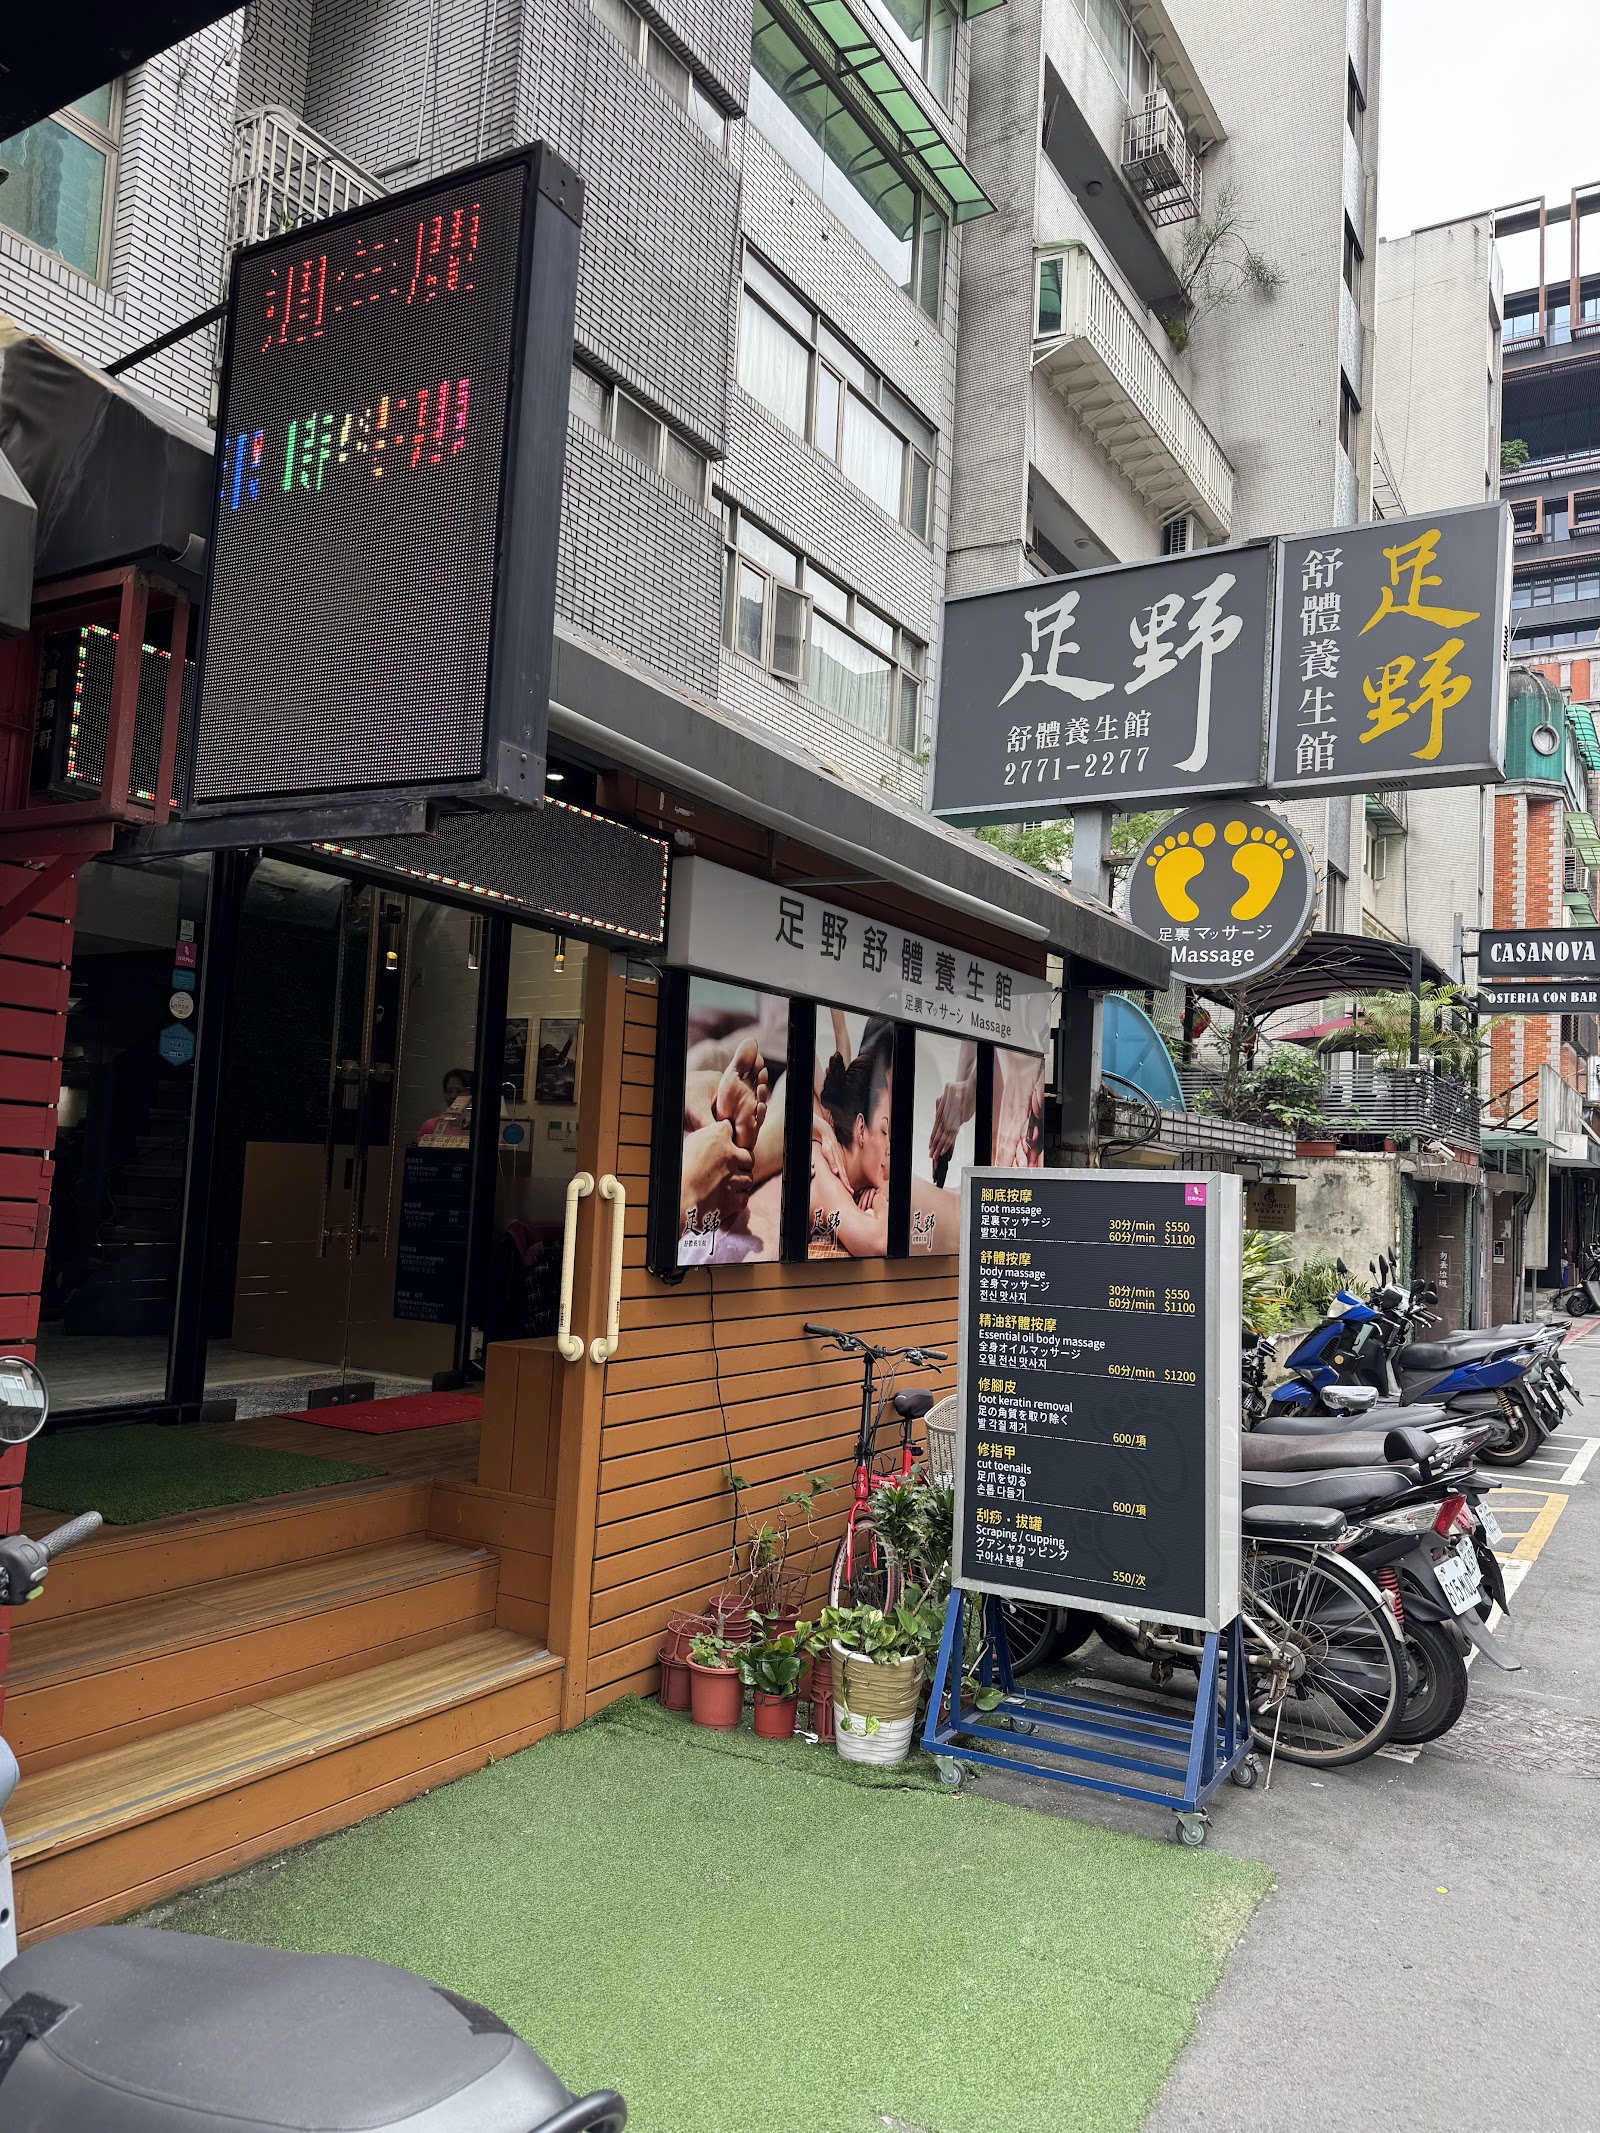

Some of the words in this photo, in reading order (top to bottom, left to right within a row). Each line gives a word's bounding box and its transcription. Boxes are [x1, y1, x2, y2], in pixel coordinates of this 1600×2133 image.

[1357, 528, 1480, 761] 足野
[1295, 546, 1344, 775] 舒體養生館
[998, 573, 1243, 772] 足野
[1007, 709, 1152, 753] 舒體養生館
[1004, 746, 1150, 786] 2771-2277
[776, 895, 1013, 1011] 足野舒體養生館
[1171, 946, 1255, 966] Massage
[1491, 941, 1596, 962] CASANOVA
[1488, 992, 1539, 1003] OSTERIA
[1543, 992, 1566, 1003] CON
[1571, 992, 1597, 1002] BAR
[971, 1012, 1012, 1038] Massage
[981, 1188, 1032, 1203] 腳底按摩
[981, 1205, 999, 1213] foot
[1002, 1206, 1042, 1216] massage
[981, 1215, 1050, 1227] 足裏マッサージ
[1109, 1220, 1155, 1231] 30分/min
[1165, 1221, 1189, 1232] $550
[1109, 1231, 1155, 1243] 60分/min
[1165, 1234, 1195, 1245] $1100
[980, 1251, 1031, 1266] 舒體按摩
[980, 1267, 1003, 1278] body
[1005, 1269, 1046, 1279] massage
[980, 1279, 1049, 1291] 全身マッサージ
[1109, 1285, 1154, 1298] 30分/min
[1165, 1289, 1189, 1300] $550
[980, 1291, 998, 1301] 전신
[1109, 1298, 1154, 1310] 60分/min
[1165, 1302, 1195, 1314] $1100
[979, 1314, 1056, 1332] 精油舒體按摩
[979, 1331, 1020, 1341] Essential
[1022, 1332, 1034, 1342] oil
[1037, 1334, 1060, 1347] body
[1063, 1337, 1105, 1349] massage
[979, 1342, 1080, 1359] 全身オイルマッサージ
[979, 1354, 996, 1364] 오일
[1109, 1365, 1155, 1378] 60分/min
[1165, 1369, 1195, 1382] $1200
[978, 1377, 1016, 1394] 修腳皮
[978, 1393, 996, 1404] foot
[999, 1395, 1031, 1408] keratin
[1034, 1399, 1073, 1412] removal
[978, 1405, 1068, 1425] 足の角質を取り除く
[978, 1418, 986, 1429] 발
[1113, 1433, 1146, 1447] 600/項
[977, 1443, 1015, 1460] 修指甲
[977, 1460, 992, 1469] cut
[994, 1461, 1031, 1474] toenails
[977, 1471, 1026, 1486] 足爪を切る
[1113, 1502, 1146, 1516] 600/項
[976, 1524, 1017, 1542] Scraping
[1019, 1530, 1023, 1541] /
[1025, 1532, 1064, 1549] cupping
[1113, 1570, 1145, 1586] 550/次
